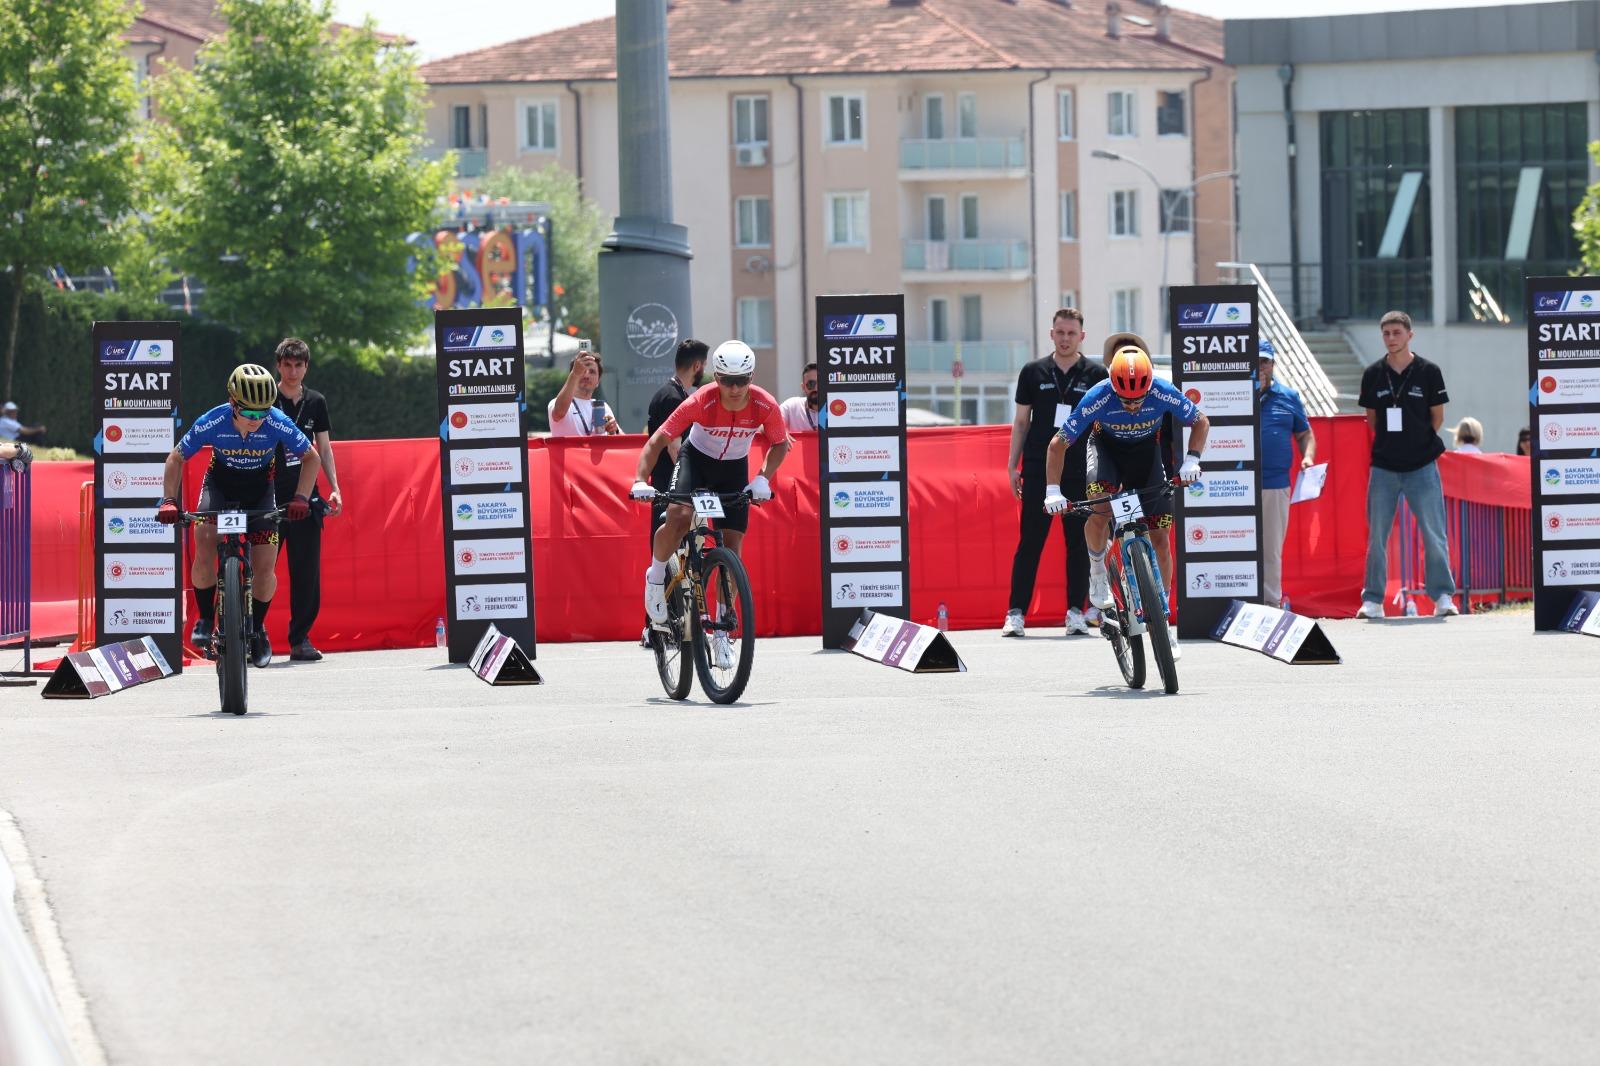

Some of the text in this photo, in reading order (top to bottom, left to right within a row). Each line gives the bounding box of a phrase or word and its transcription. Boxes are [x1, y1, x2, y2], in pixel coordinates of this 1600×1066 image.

[1538, 322, 1600, 341] START
[1182, 335, 1250, 354] START
[1556, 349, 1600, 358] MOUNTAINBIK
[828, 346, 896, 365] START
[449, 357, 515, 378] START
[1201, 361, 1251, 370] MOUNTAINBIKE
[105, 372, 171, 390] START
[847, 372, 896, 381] MOUNTAINBIKE
[467, 384, 516, 393] MOUNTAINBIKE
[1150, 387, 1181, 406] Auchan
[123, 399, 171, 408] MOUNTAINBIKE
[1081, 393, 1111, 417] Auchan
[194, 415, 225, 435] Auchan
[265, 414, 294, 435] Auchan
[700, 499, 717, 510] 12
[1121, 500, 1132, 513] 5
[224, 516, 239, 526] 21
